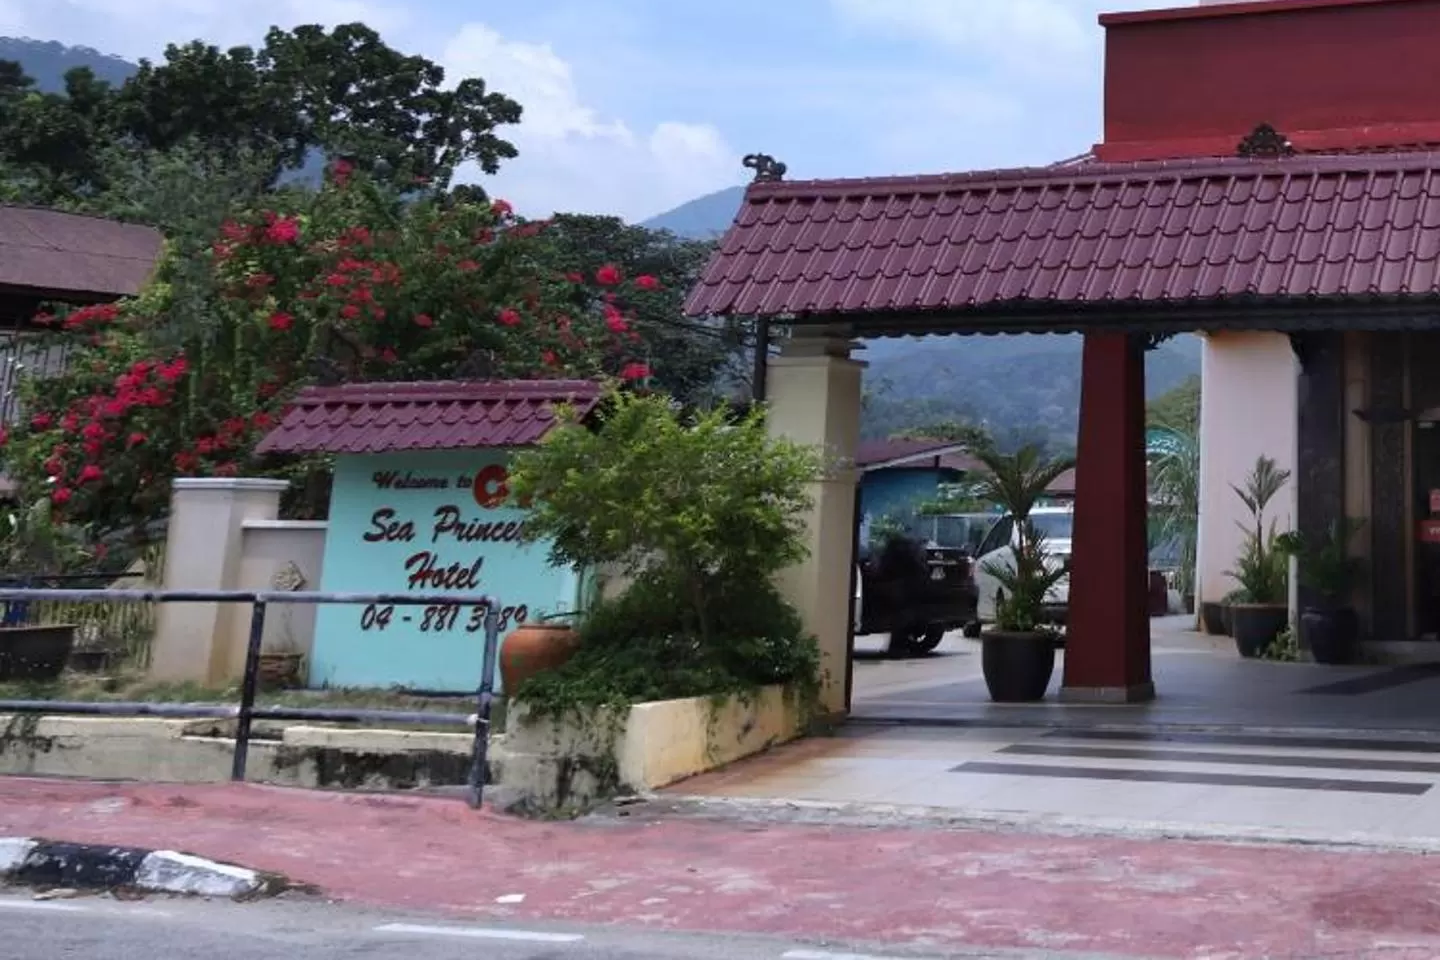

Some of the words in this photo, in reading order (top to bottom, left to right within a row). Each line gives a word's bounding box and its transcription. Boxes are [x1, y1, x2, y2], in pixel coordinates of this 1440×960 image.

[371, 469, 448, 490] Welcome
[456, 473, 472, 490] to
[363, 507, 416, 543] Sea
[430, 504, 526, 544] Prince
[404, 550, 484, 590] Hotel
[360, 604, 393, 632] 04
